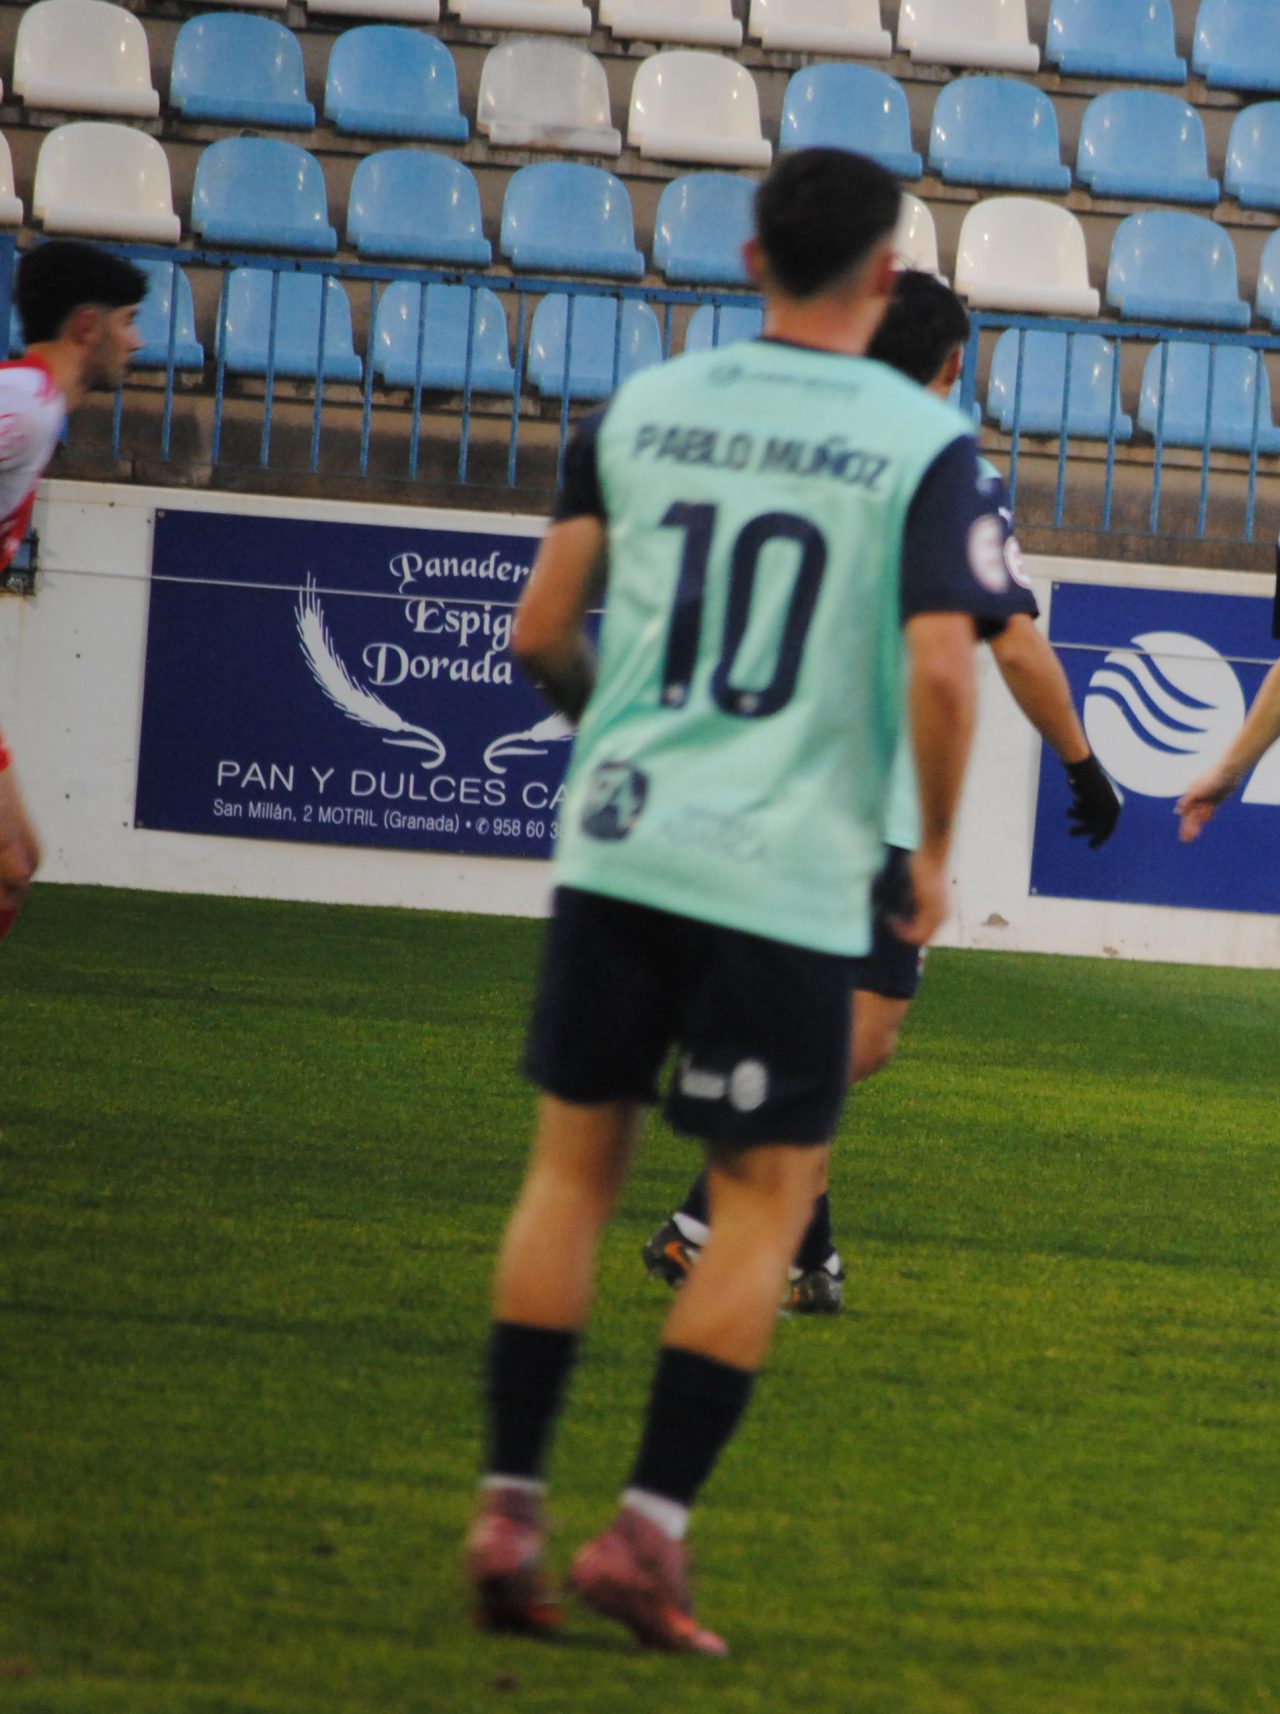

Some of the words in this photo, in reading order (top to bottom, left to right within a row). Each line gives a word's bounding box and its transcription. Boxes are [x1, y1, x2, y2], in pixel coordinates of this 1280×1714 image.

[634, 423, 752, 471] PABLO
[758, 434, 890, 490] MUÑOZ
[405, 600, 516, 651] Espig
[658, 499, 828, 719] 10
[362, 642, 513, 686] Dorada
[217, 760, 294, 792] PAN
[311, 766, 335, 794] Y
[351, 769, 506, 807] DULCES
[213, 798, 243, 818] San
[303, 804, 313, 823] 2
[318, 806, 378, 828] MOTRIL
[383, 808, 460, 834] (Granada)
[493, 817, 521, 837] 958
[526, 820, 545, 839] 60
